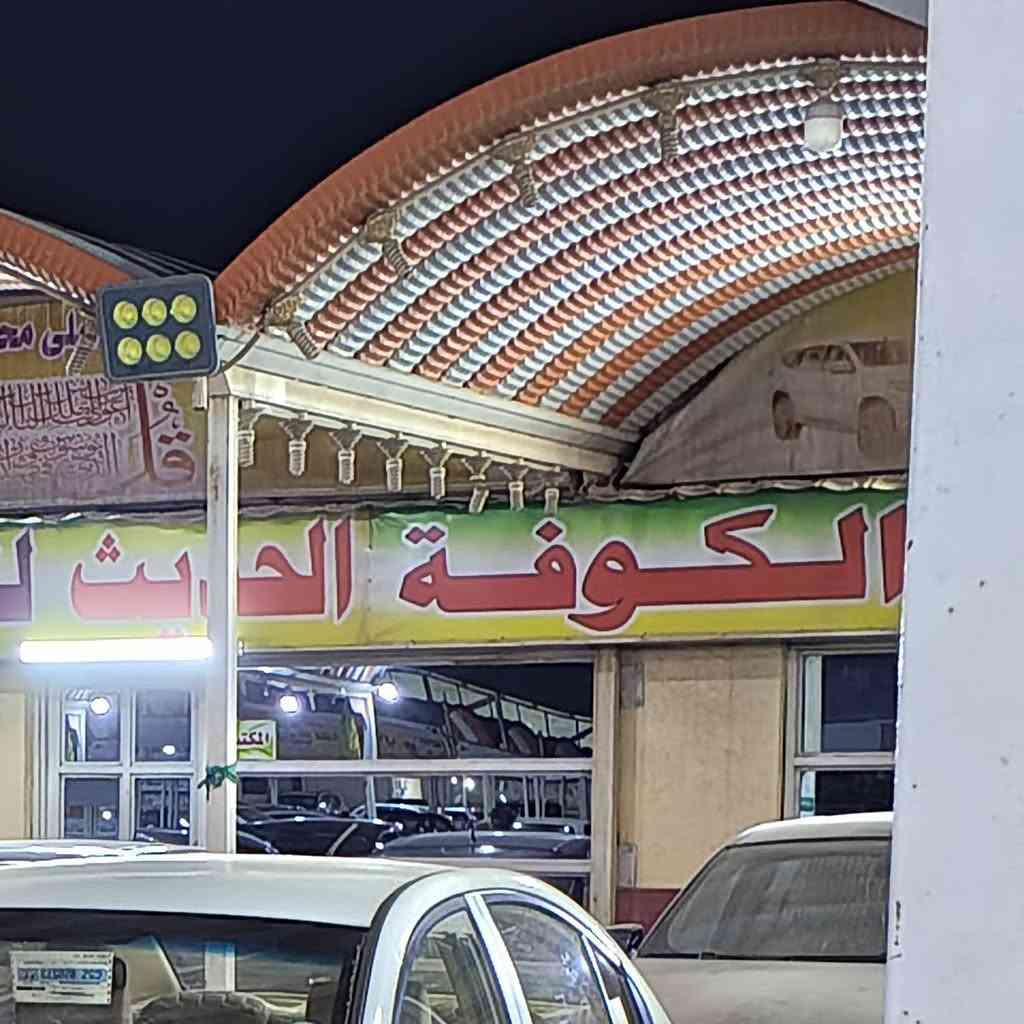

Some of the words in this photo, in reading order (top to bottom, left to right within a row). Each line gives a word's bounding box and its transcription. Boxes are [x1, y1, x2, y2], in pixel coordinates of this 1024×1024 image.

[42, 311, 81, 357] لى
[71, 517, 351, 632] الحيث
[399, 504, 906, 632] الكوفة
[237, 731, 269, 746] المكت
